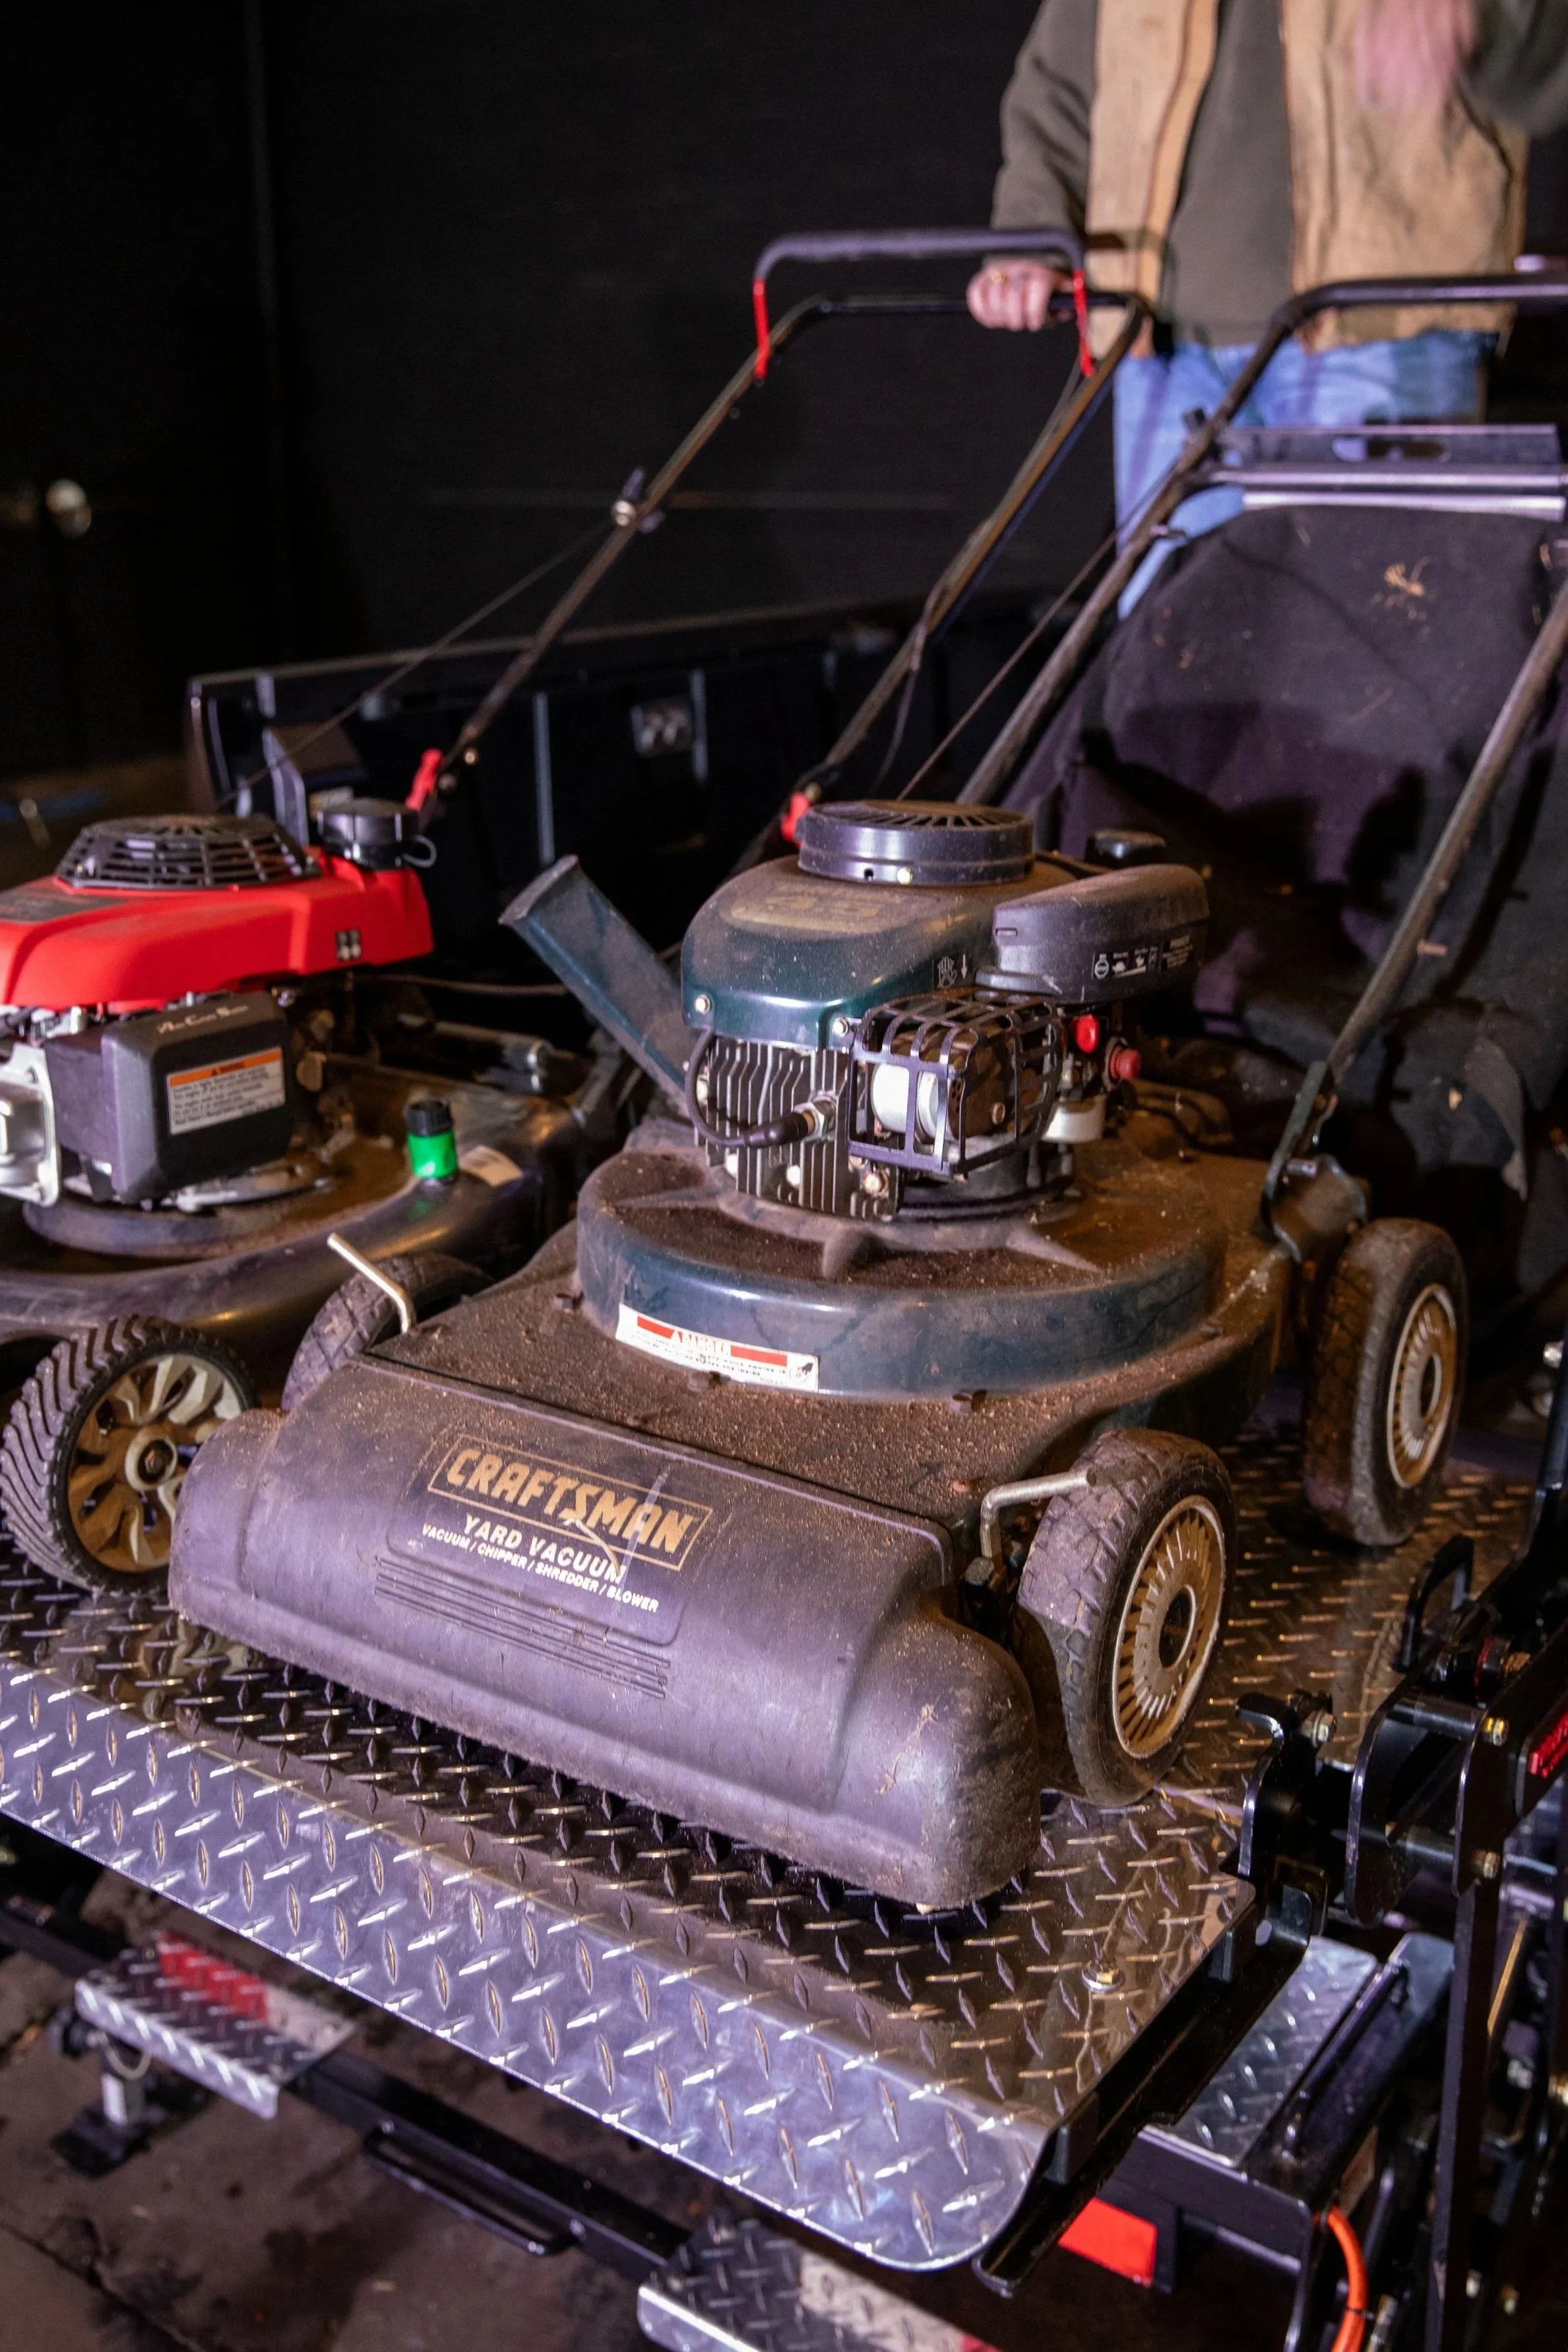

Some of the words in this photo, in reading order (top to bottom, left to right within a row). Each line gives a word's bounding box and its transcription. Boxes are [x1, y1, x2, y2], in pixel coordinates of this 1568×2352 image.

[447, 1449, 694, 1554] CRAFTSMAN
[422, 1523, 470, 1550] VACUUM
[477, 1542, 527, 1569] CHIPPER
[535, 1561, 599, 1594] SHREDDER
[606, 1585, 659, 1613] BLOWER
[464, 1514, 522, 1549] YARD
[528, 1535, 627, 1583] VACUUM
